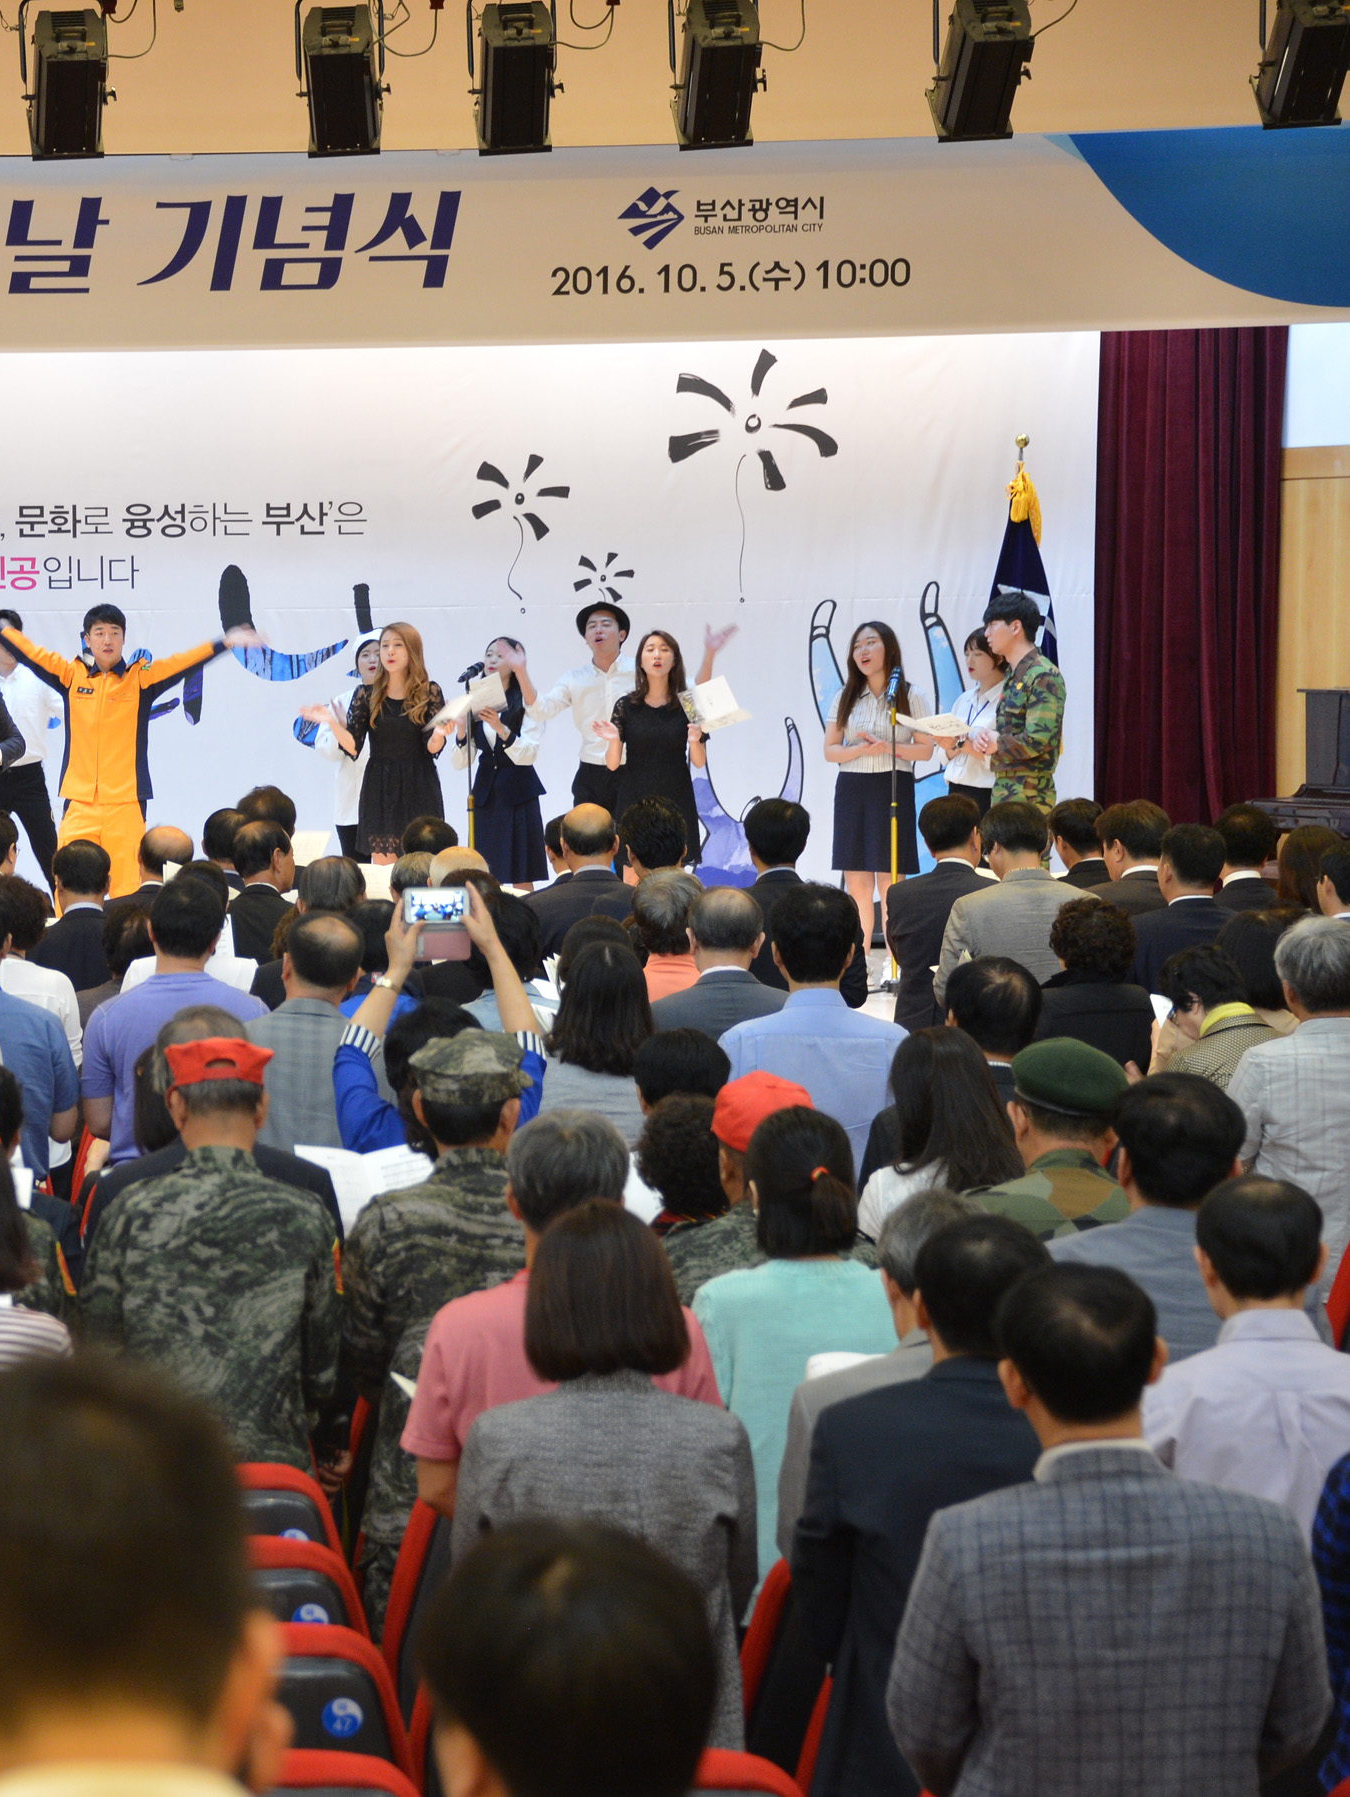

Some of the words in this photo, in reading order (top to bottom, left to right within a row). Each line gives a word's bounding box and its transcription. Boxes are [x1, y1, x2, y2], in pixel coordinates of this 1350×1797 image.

[694, 196, 825, 223] 부산광역시
[5, 197, 111, 295] 날
[136, 190, 462, 292] 기념식
[694, 225, 724, 236] BUSAN
[728, 223, 798, 235] METROPOLITAN
[801, 222, 824, 233] CITY
[551, 265, 645, 295] 2016.
[656, 263, 707, 293] 10.
[815, 257, 911, 290] 10:00
[14, 504, 114, 539] 문화로
[121, 502, 253, 539] 융성하는
